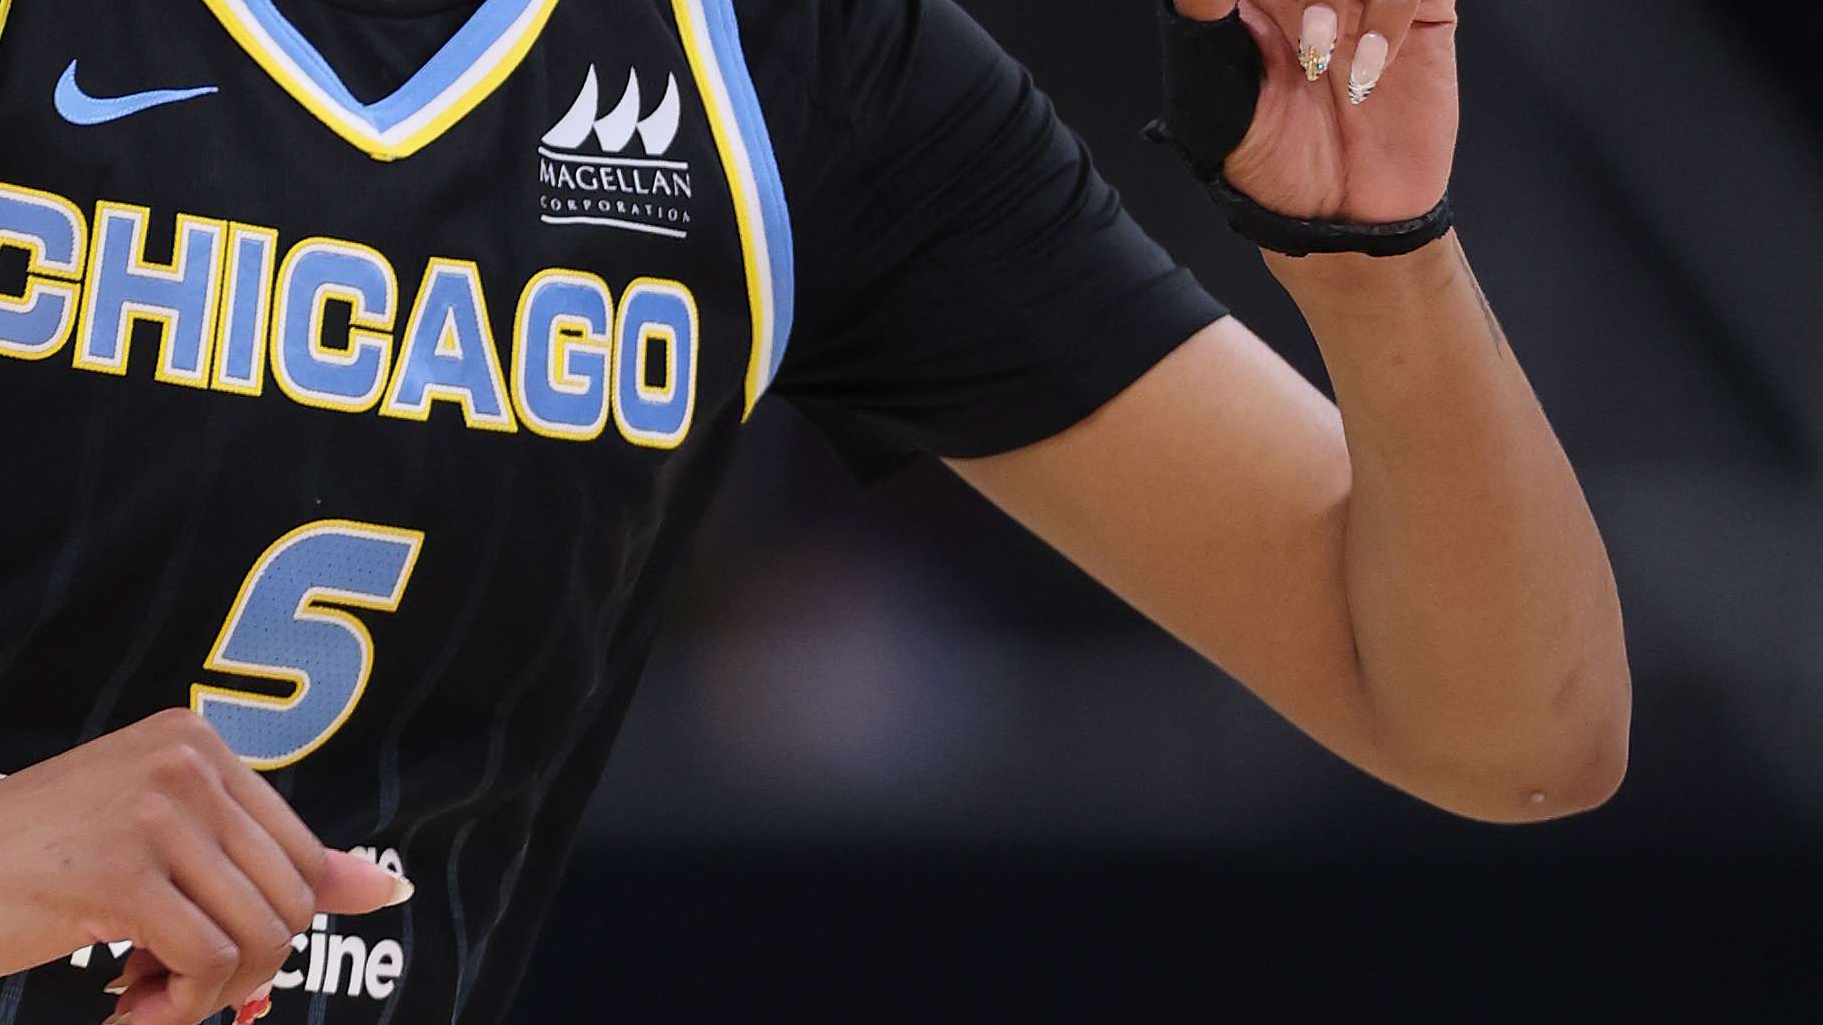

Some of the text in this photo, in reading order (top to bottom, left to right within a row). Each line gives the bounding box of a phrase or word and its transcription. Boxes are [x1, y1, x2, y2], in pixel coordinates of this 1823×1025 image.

[539, 158, 692, 199] MAGELLAN
[539, 194, 691, 223] CORPORATION
[189, 519, 426, 771] 5
